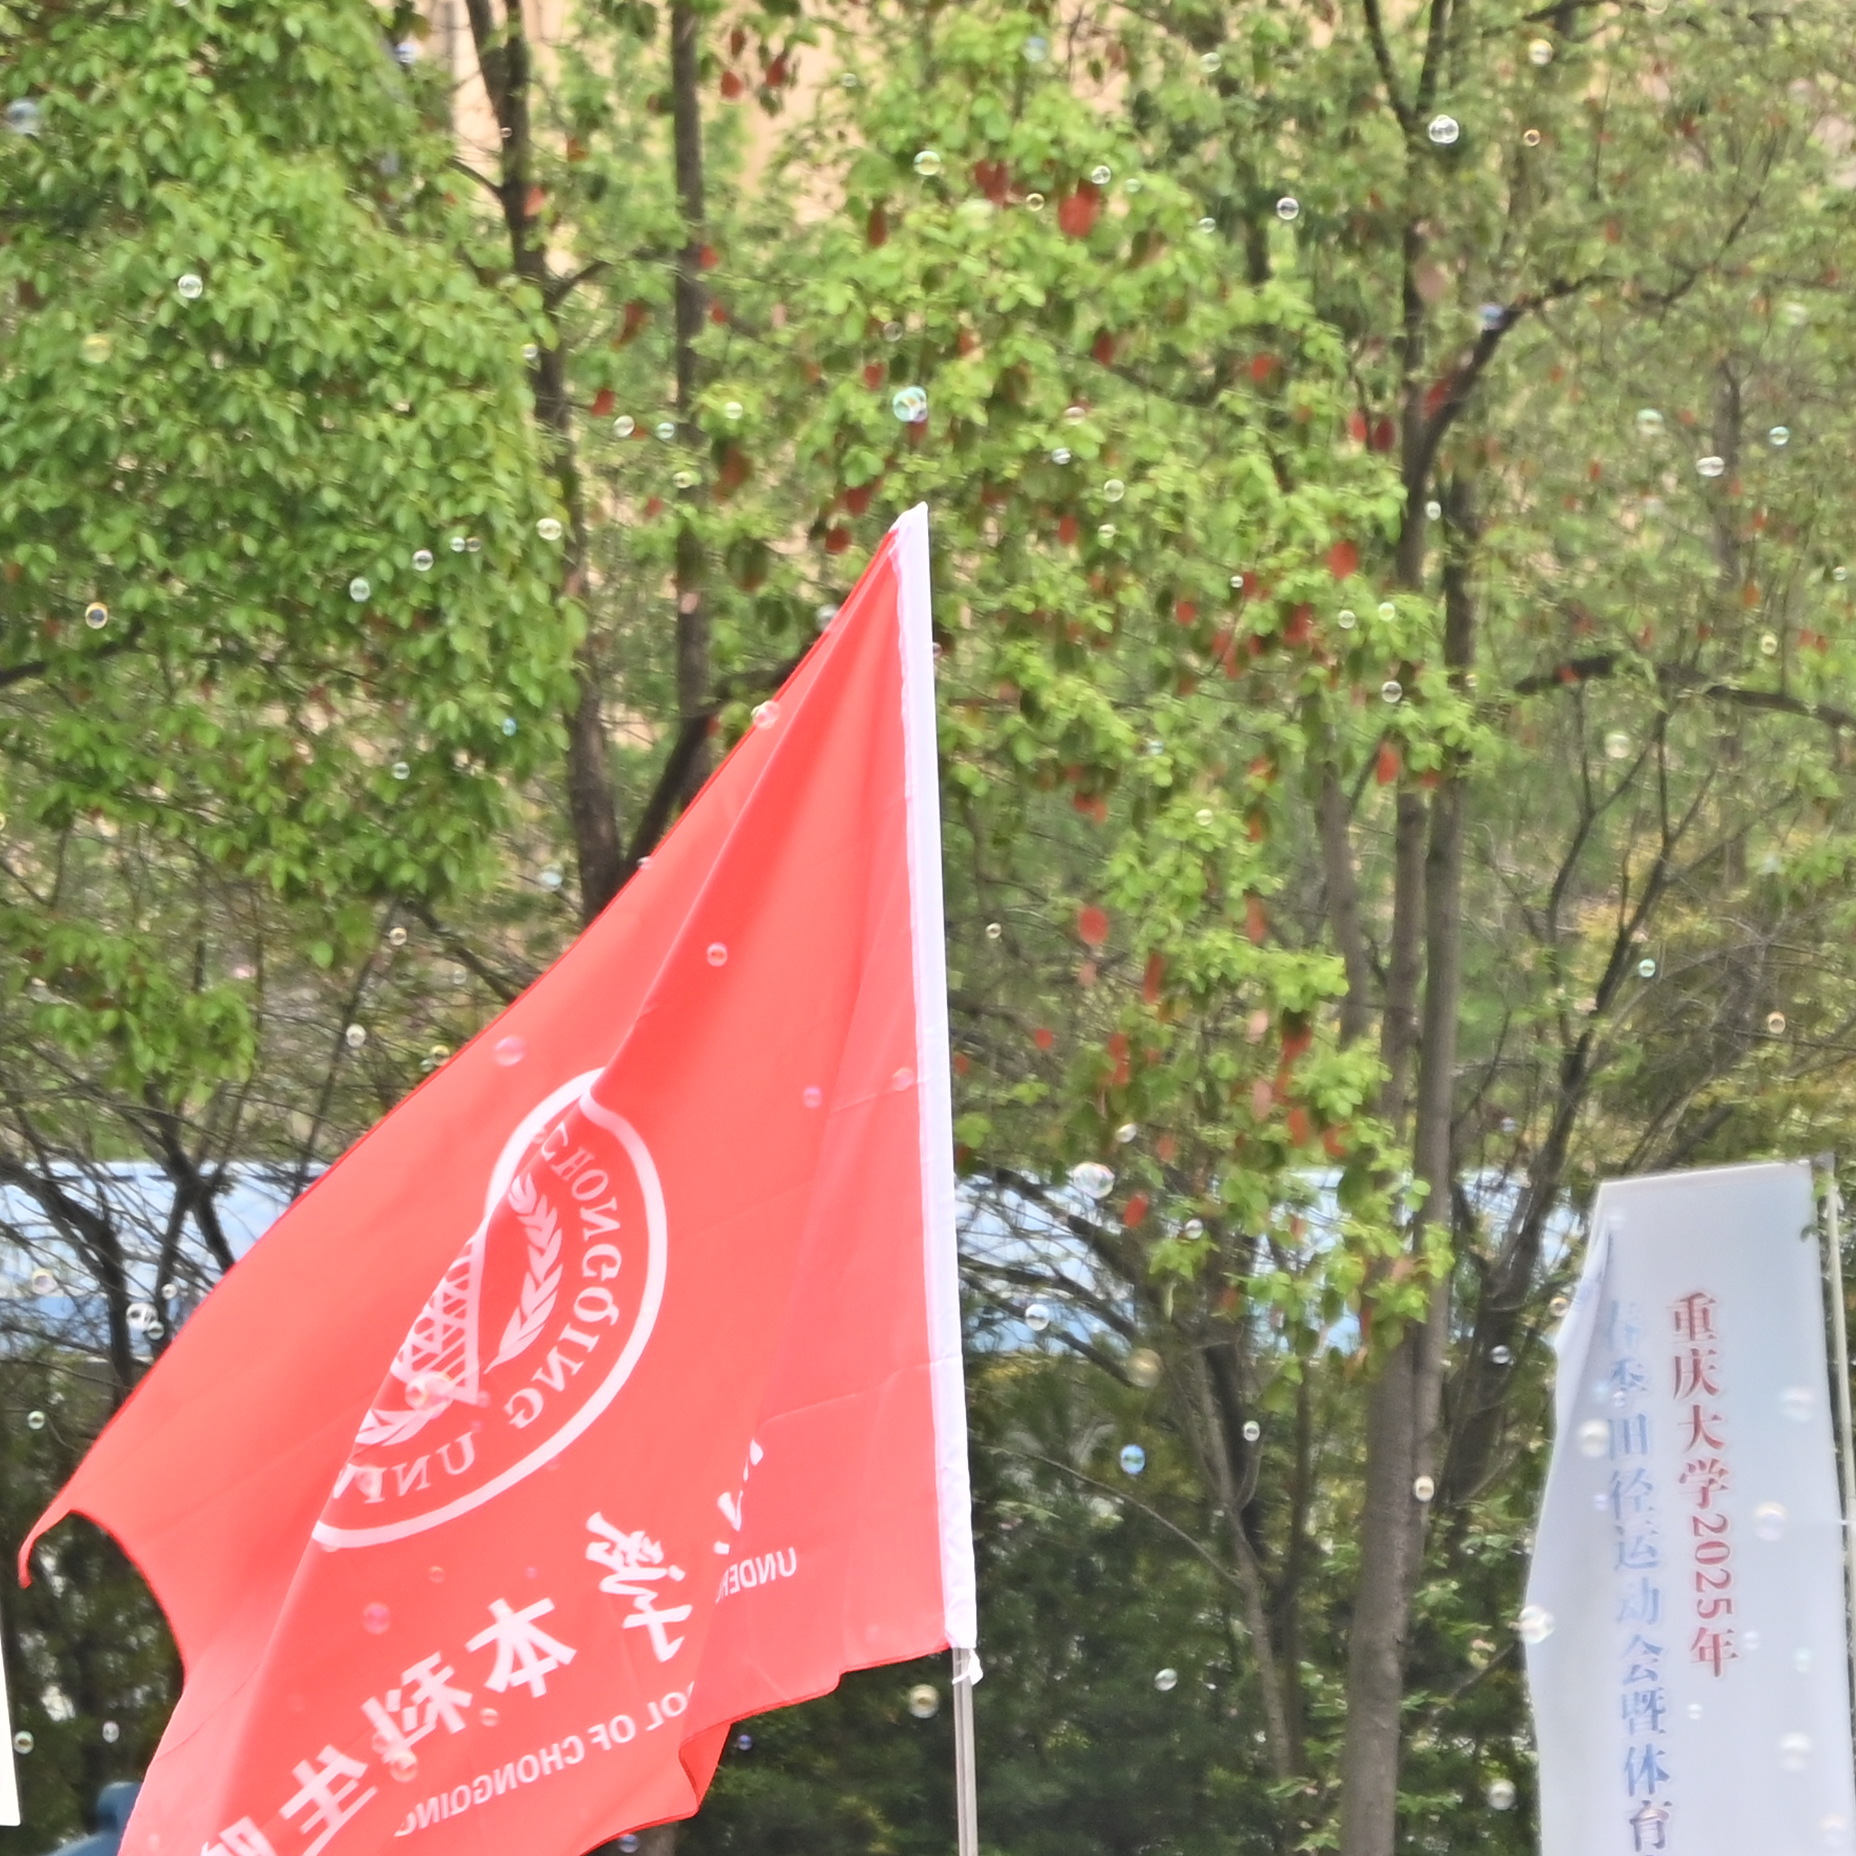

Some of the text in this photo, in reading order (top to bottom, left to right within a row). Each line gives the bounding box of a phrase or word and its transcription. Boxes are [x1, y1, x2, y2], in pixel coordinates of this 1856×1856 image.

[1665, 1291, 1739, 1678] 重庆大学2025年
